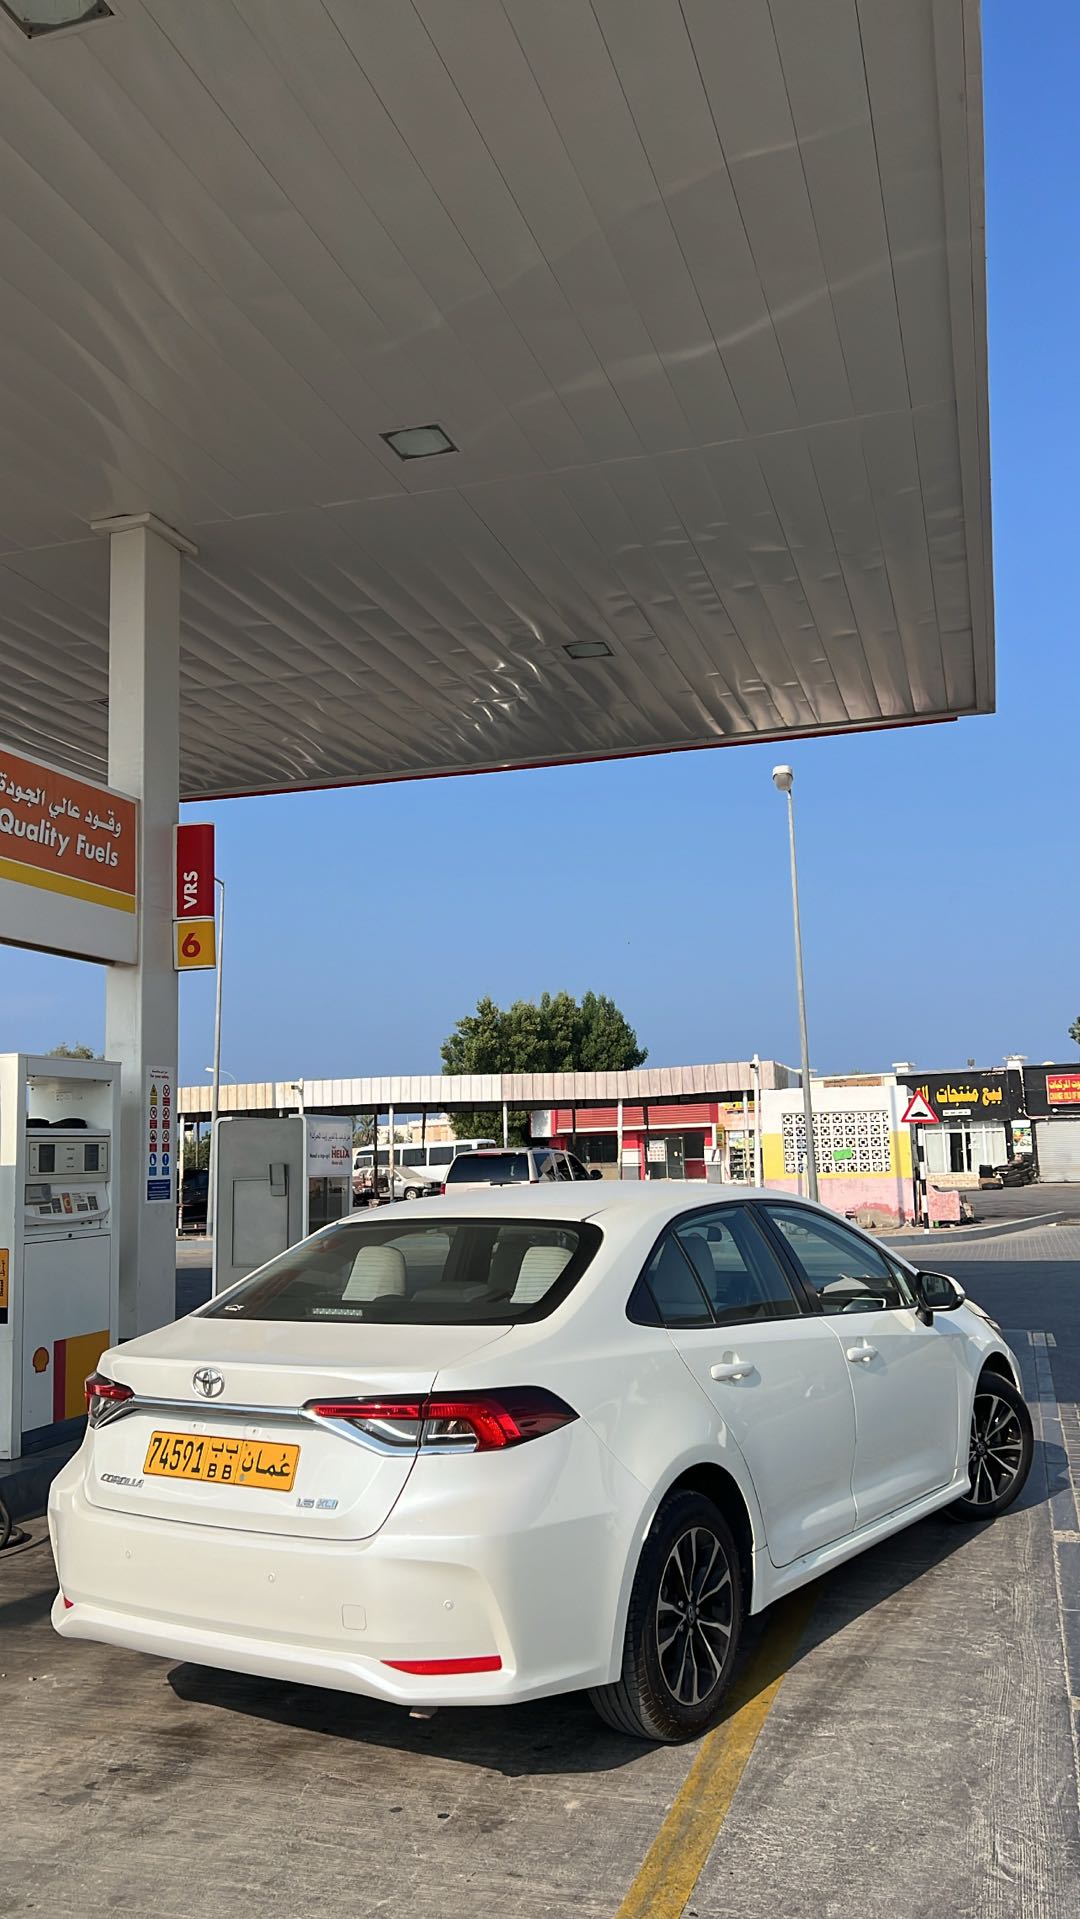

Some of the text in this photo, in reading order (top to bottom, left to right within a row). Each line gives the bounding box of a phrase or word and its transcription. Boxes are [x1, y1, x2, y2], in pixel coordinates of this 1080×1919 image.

[48, 798, 81, 819] عالي
[0, 807, 119, 868] Quality Fuels
[84, 810, 122, 838] وقود
[183, 870, 198, 910] VRS
[181, 932, 201, 958] 6
[936, 1084, 979, 1107] منتجات
[982, 1085, 1003, 1106] بيع
[149, 1437, 204, 1473] 74591
